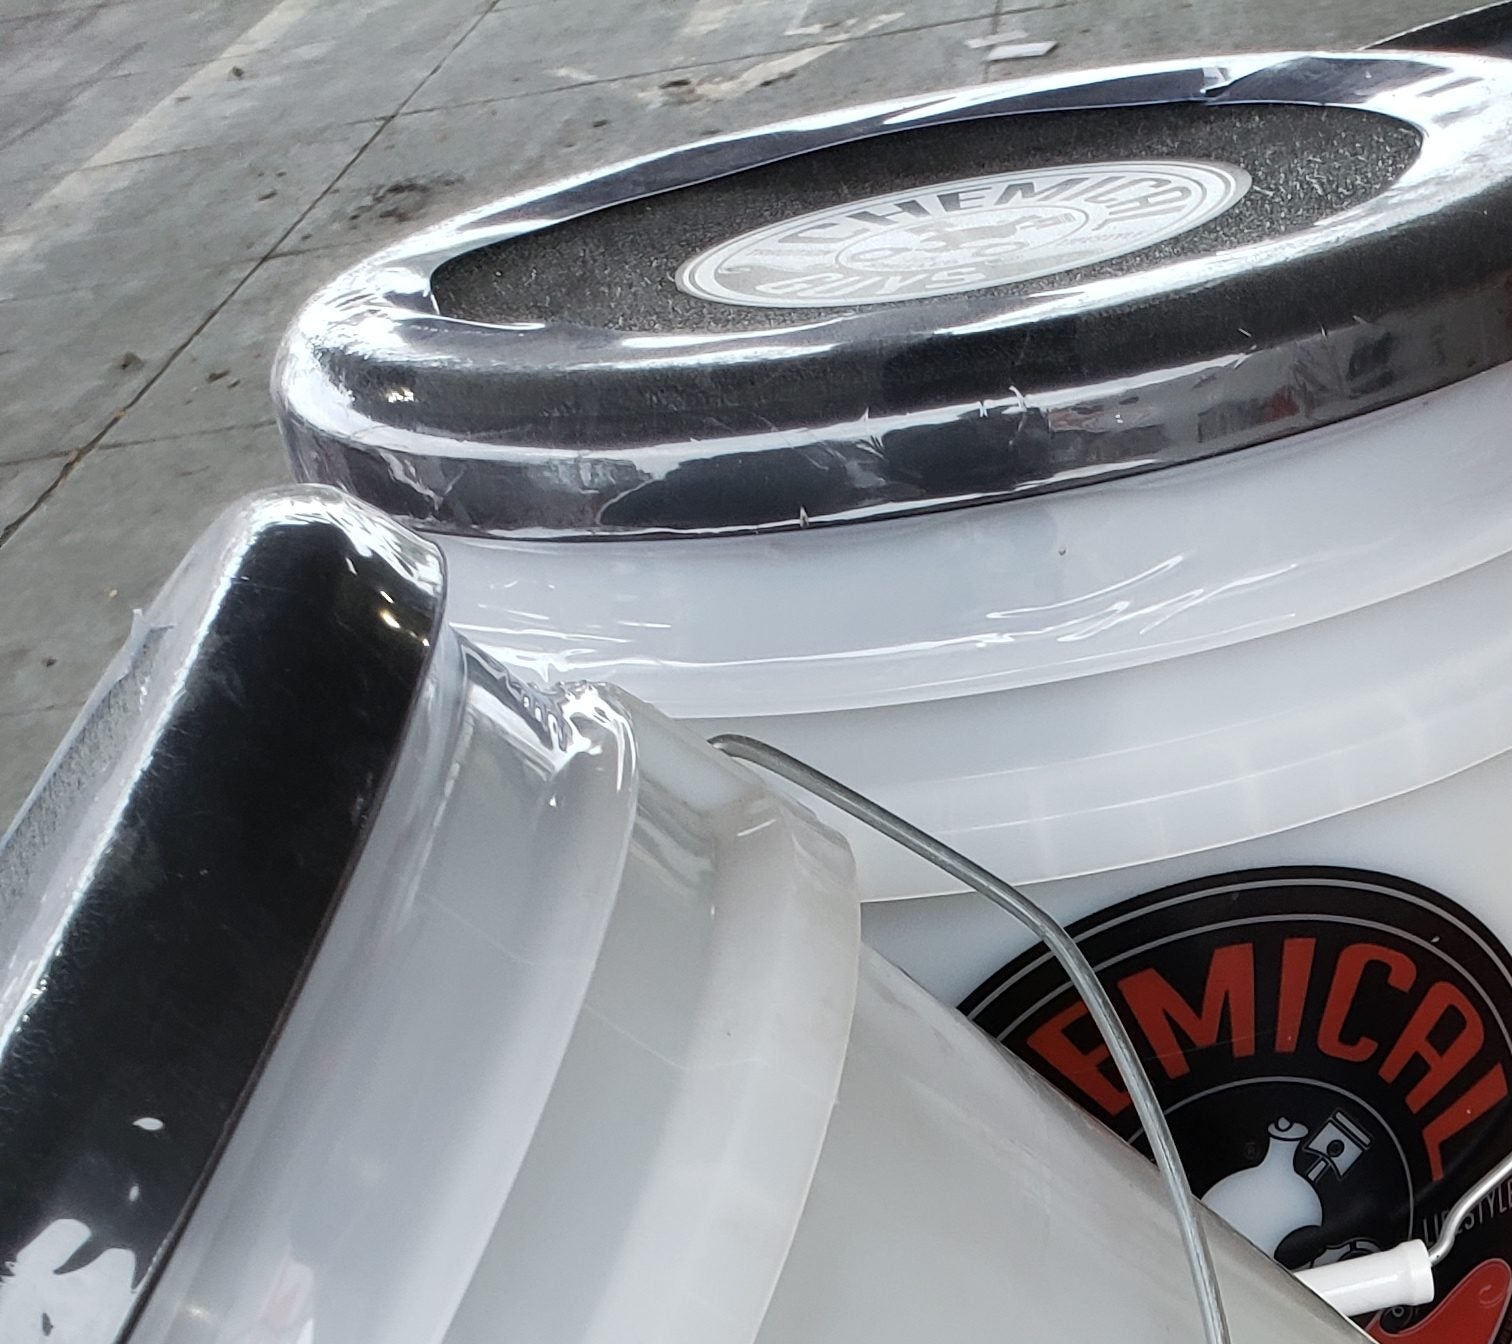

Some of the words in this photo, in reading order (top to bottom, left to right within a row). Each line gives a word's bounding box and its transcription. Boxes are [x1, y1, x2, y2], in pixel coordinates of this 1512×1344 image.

[778, 175, 1192, 244] CHEMICAL
[754, 266, 987, 297] GUYS
[1026, 936, 1508, 1182] EMICAL
